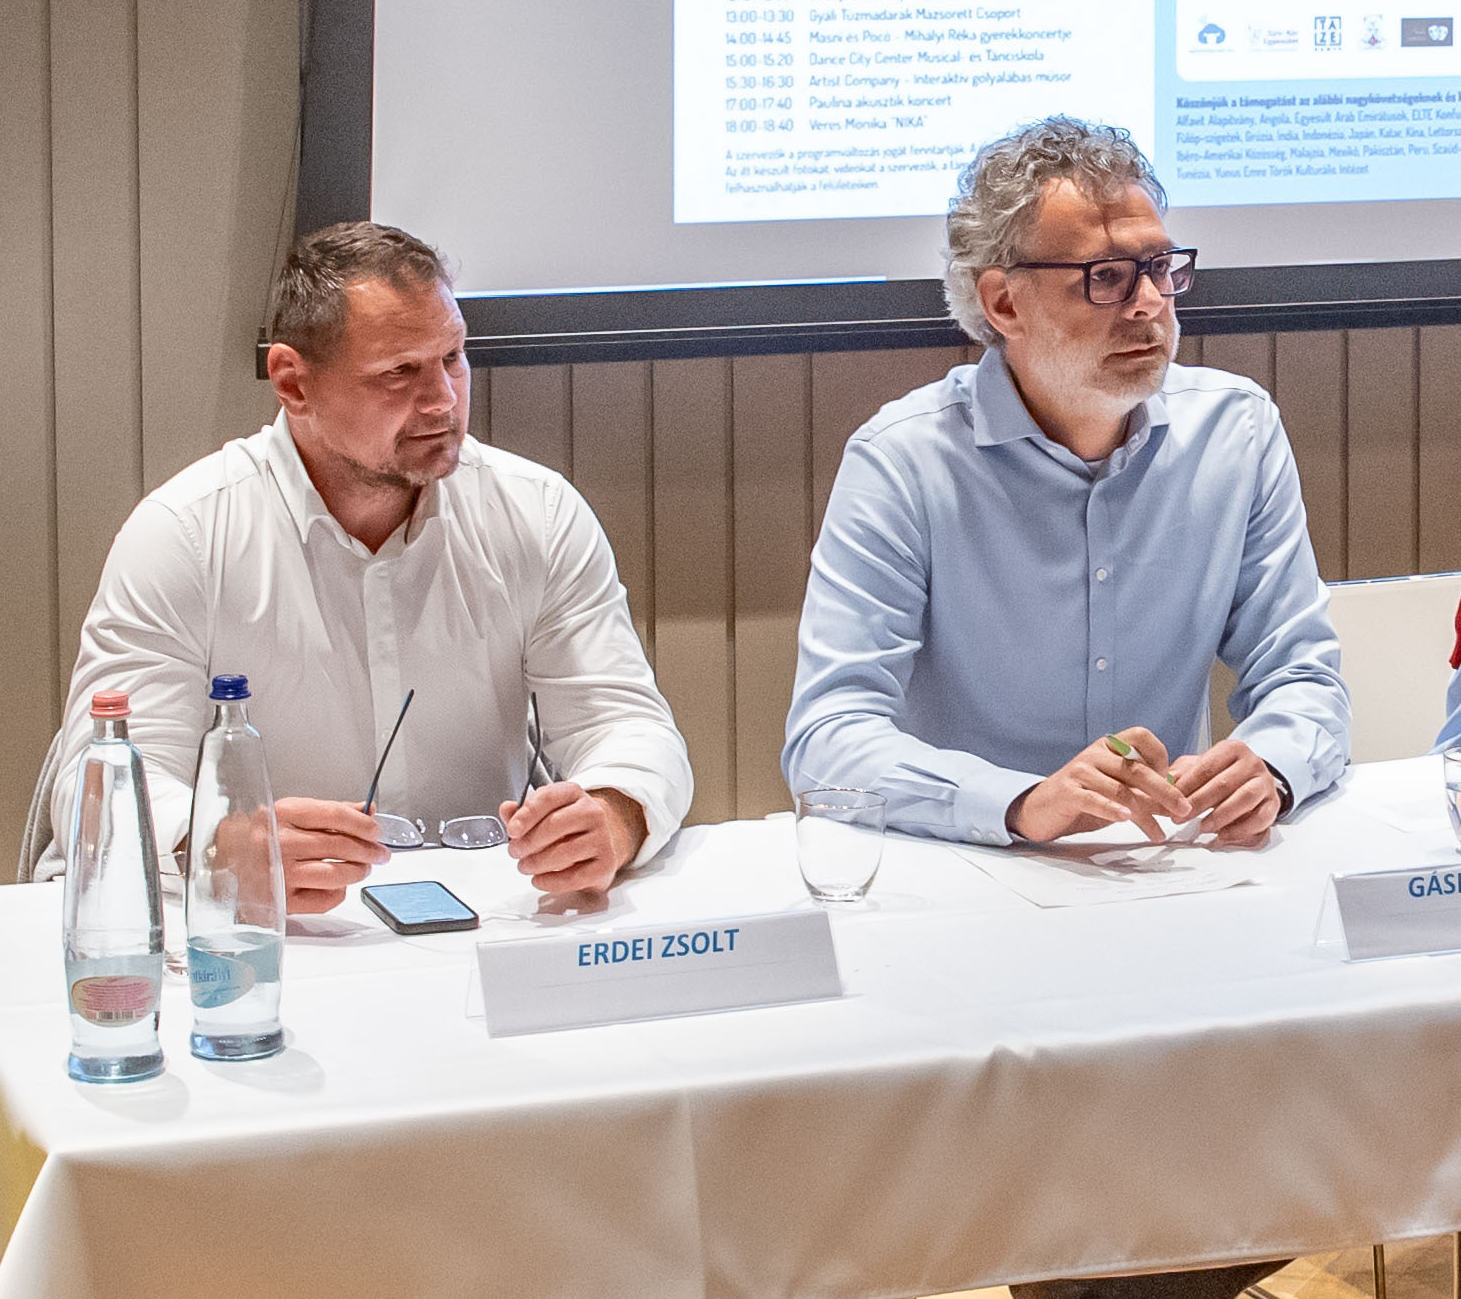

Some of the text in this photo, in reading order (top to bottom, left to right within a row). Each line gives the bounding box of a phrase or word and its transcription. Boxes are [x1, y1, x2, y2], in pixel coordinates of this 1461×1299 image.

[976, 7, 1022, 21] Csoport
[844, 73, 900, 90] Company
[907, 94, 952, 108] koncert
[577, 927, 741, 968] ERDEI ZSOLT
